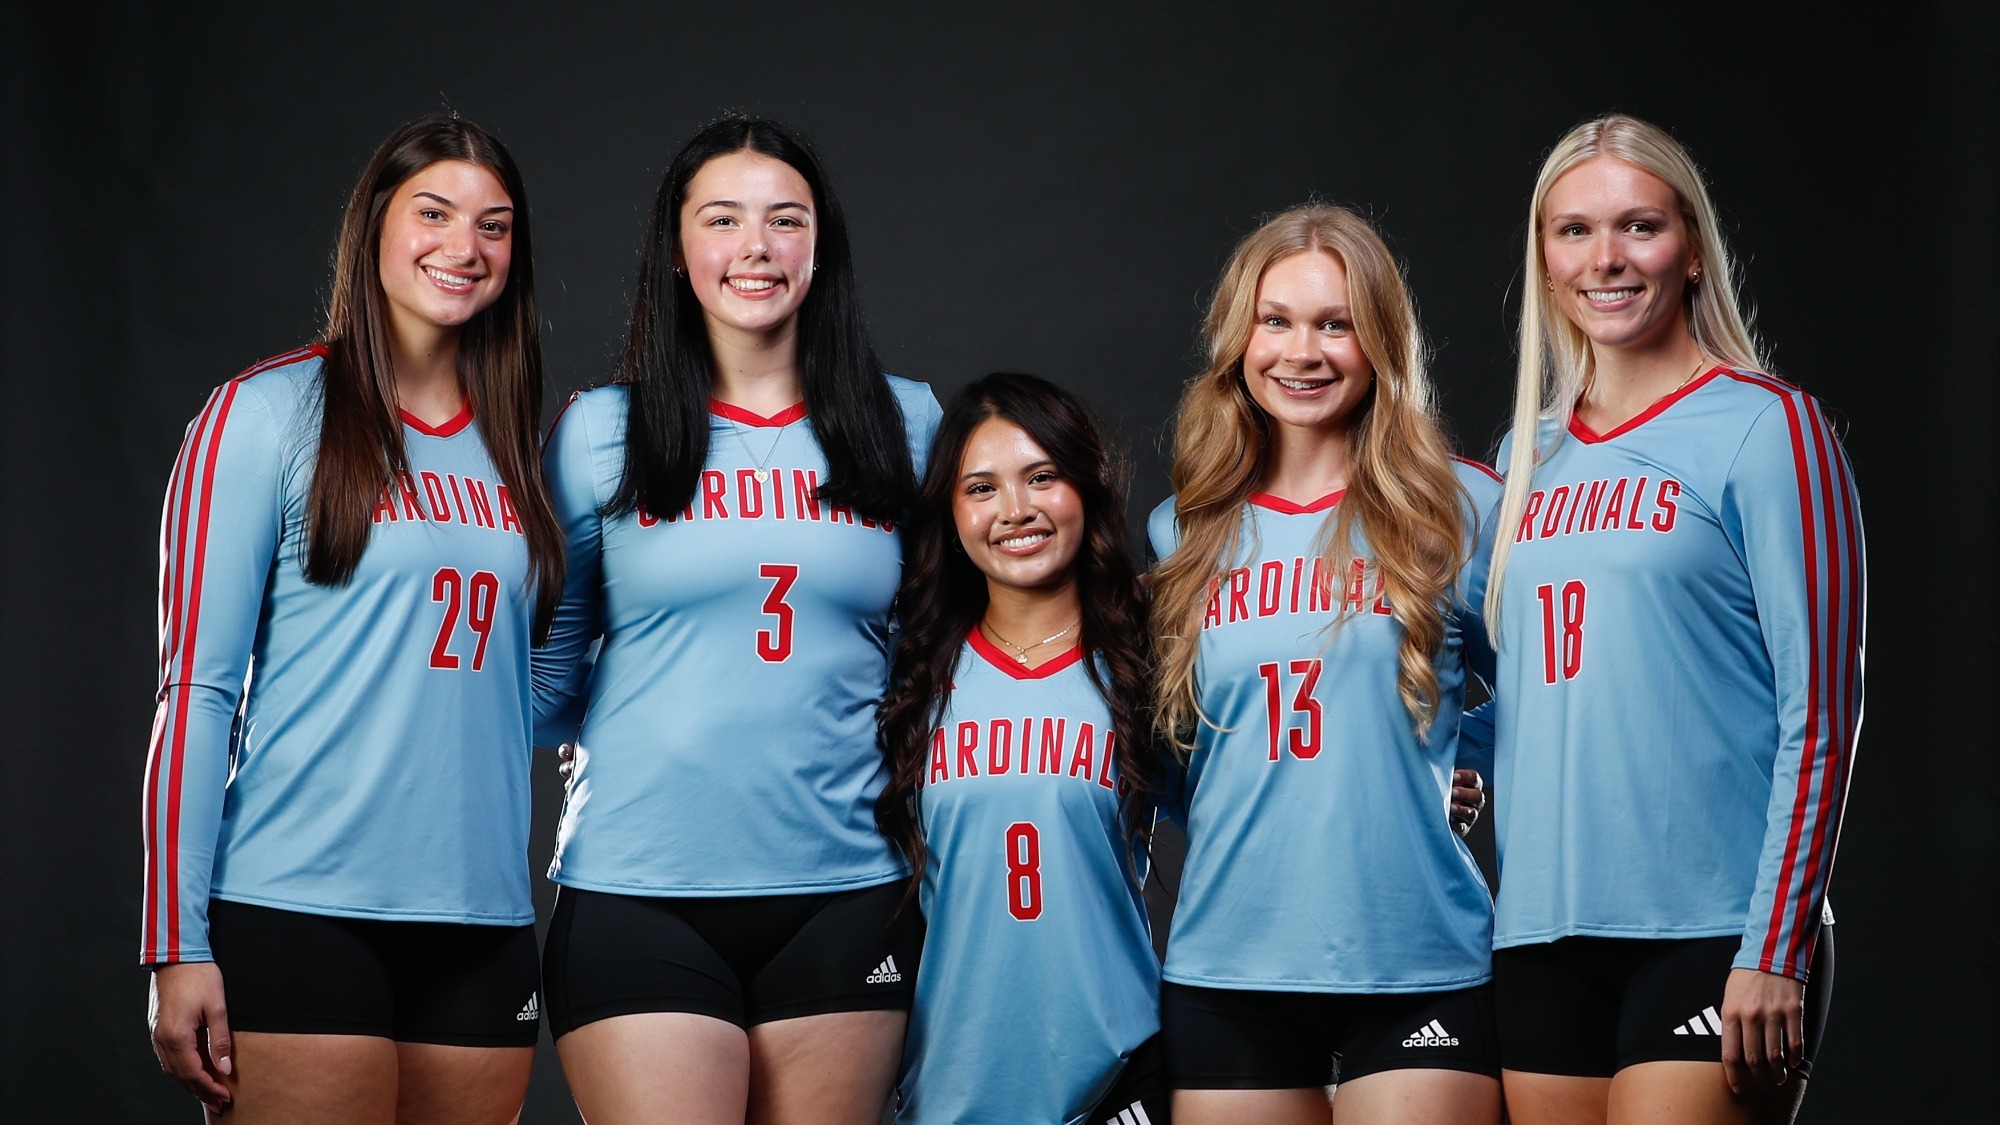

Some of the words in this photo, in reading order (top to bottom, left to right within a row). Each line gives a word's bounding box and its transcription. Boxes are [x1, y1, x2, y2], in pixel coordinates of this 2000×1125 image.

[372, 468, 524, 535] ARDINA
[1514, 476, 1681, 544] RDINALS
[429, 566, 500, 672] 29
[756, 563, 799, 663] 3
[1202, 556, 1393, 631] ARDINAL
[1536, 579, 1587, 685] 18
[1258, 658, 1323, 762] 13
[914, 716, 1131, 798] ARDINAL
[1004, 822, 1043, 921] 8
[866, 972, 902, 983] adidas
[1402, 1036, 1459, 1047] adidas
